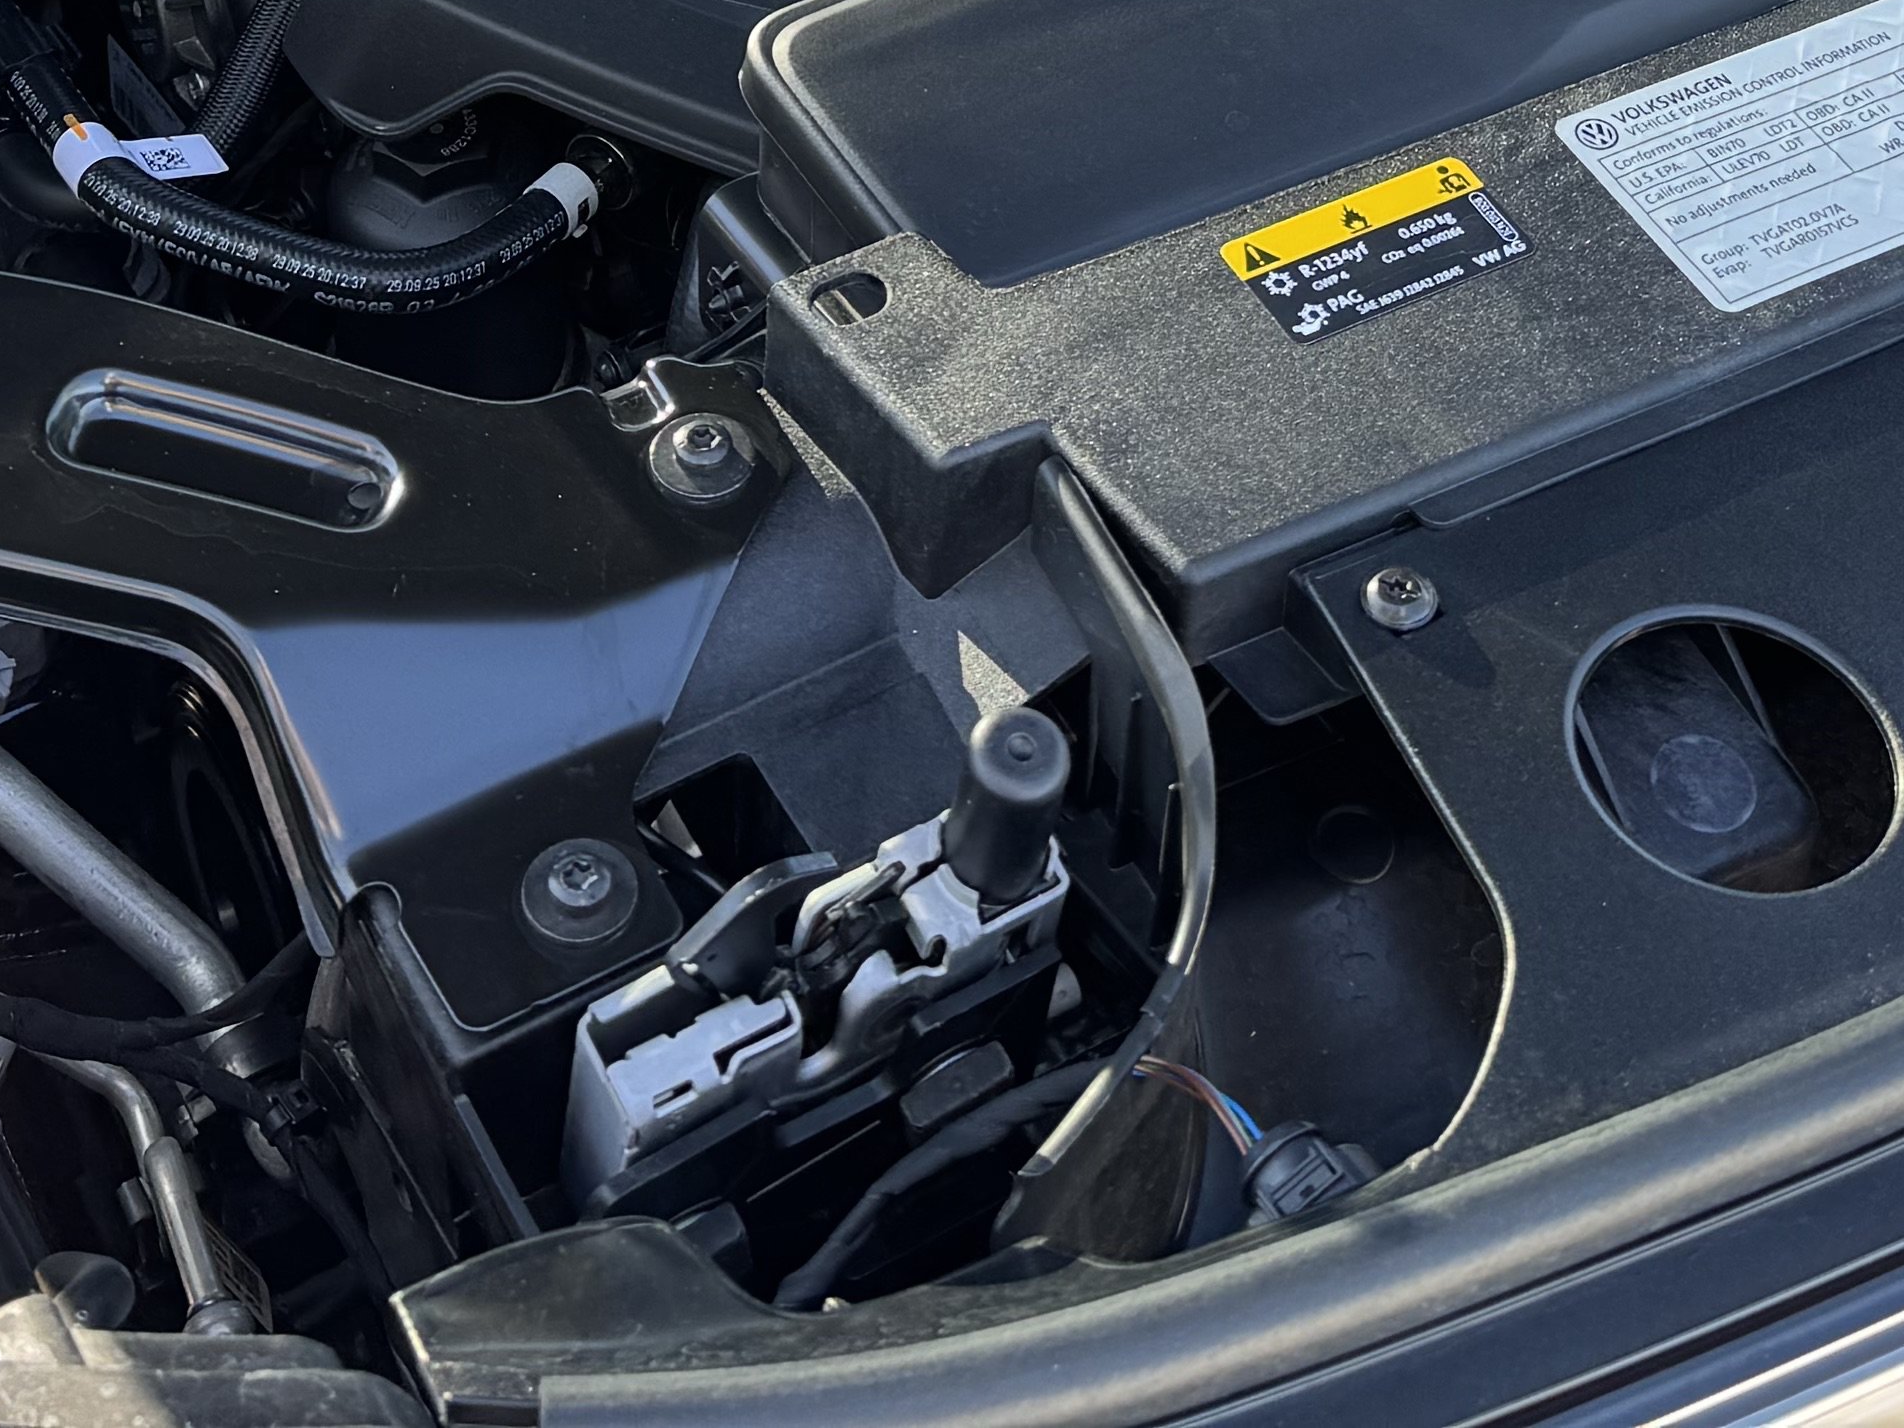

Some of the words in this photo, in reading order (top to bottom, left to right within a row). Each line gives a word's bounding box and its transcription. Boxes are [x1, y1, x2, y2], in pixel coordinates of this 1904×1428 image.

[1624, 109, 1680, 136] VEHICLE
[1678, 87, 1743, 116] EMISSION
[1742, 65, 1803, 93] CONTROL
[1800, 31, 1891, 71] INFORMATION
[1610, 73, 1732, 123] VOLKSWAGEN
[1805, 103, 1840, 120] OBD:
[1842, 93, 1864, 106] CA
[1821, 118, 1856, 136] OBD:
[1857, 108, 1880, 122] CA
[1612, 141, 1676, 170] Conforms
[1674, 135, 1692, 145] to
[1692, 109, 1767, 140] regulations:
[1706, 137, 1746, 158] BIN70
[1763, 118, 1797, 137] LDT2
[1721, 150, 1770, 174] ULEV70
[1778, 135, 1804, 152] LDT
[1644, 175, 1712, 204] California:
[1664, 214, 1687, 226] No
[1687, 183, 1768, 219] adjustments
[1768, 162, 1816, 187] needed
[1297, 240, 1368, 277] R-1234yf
[1397, 217, 1435, 238] 0.650
[1433, 212, 1457, 225] kg
[1471, 248, 1500, 266] VW
[1502, 239, 1526, 257] AG
[1700, 243, 1749, 264] Group:
[1311, 274, 1338, 290] GWP
[1339, 270, 1350, 279] 4
[1711, 260, 1751, 278] Evap:
[1326, 288, 1364, 311] PAG
[1355, 299, 1379, 314] SAE
